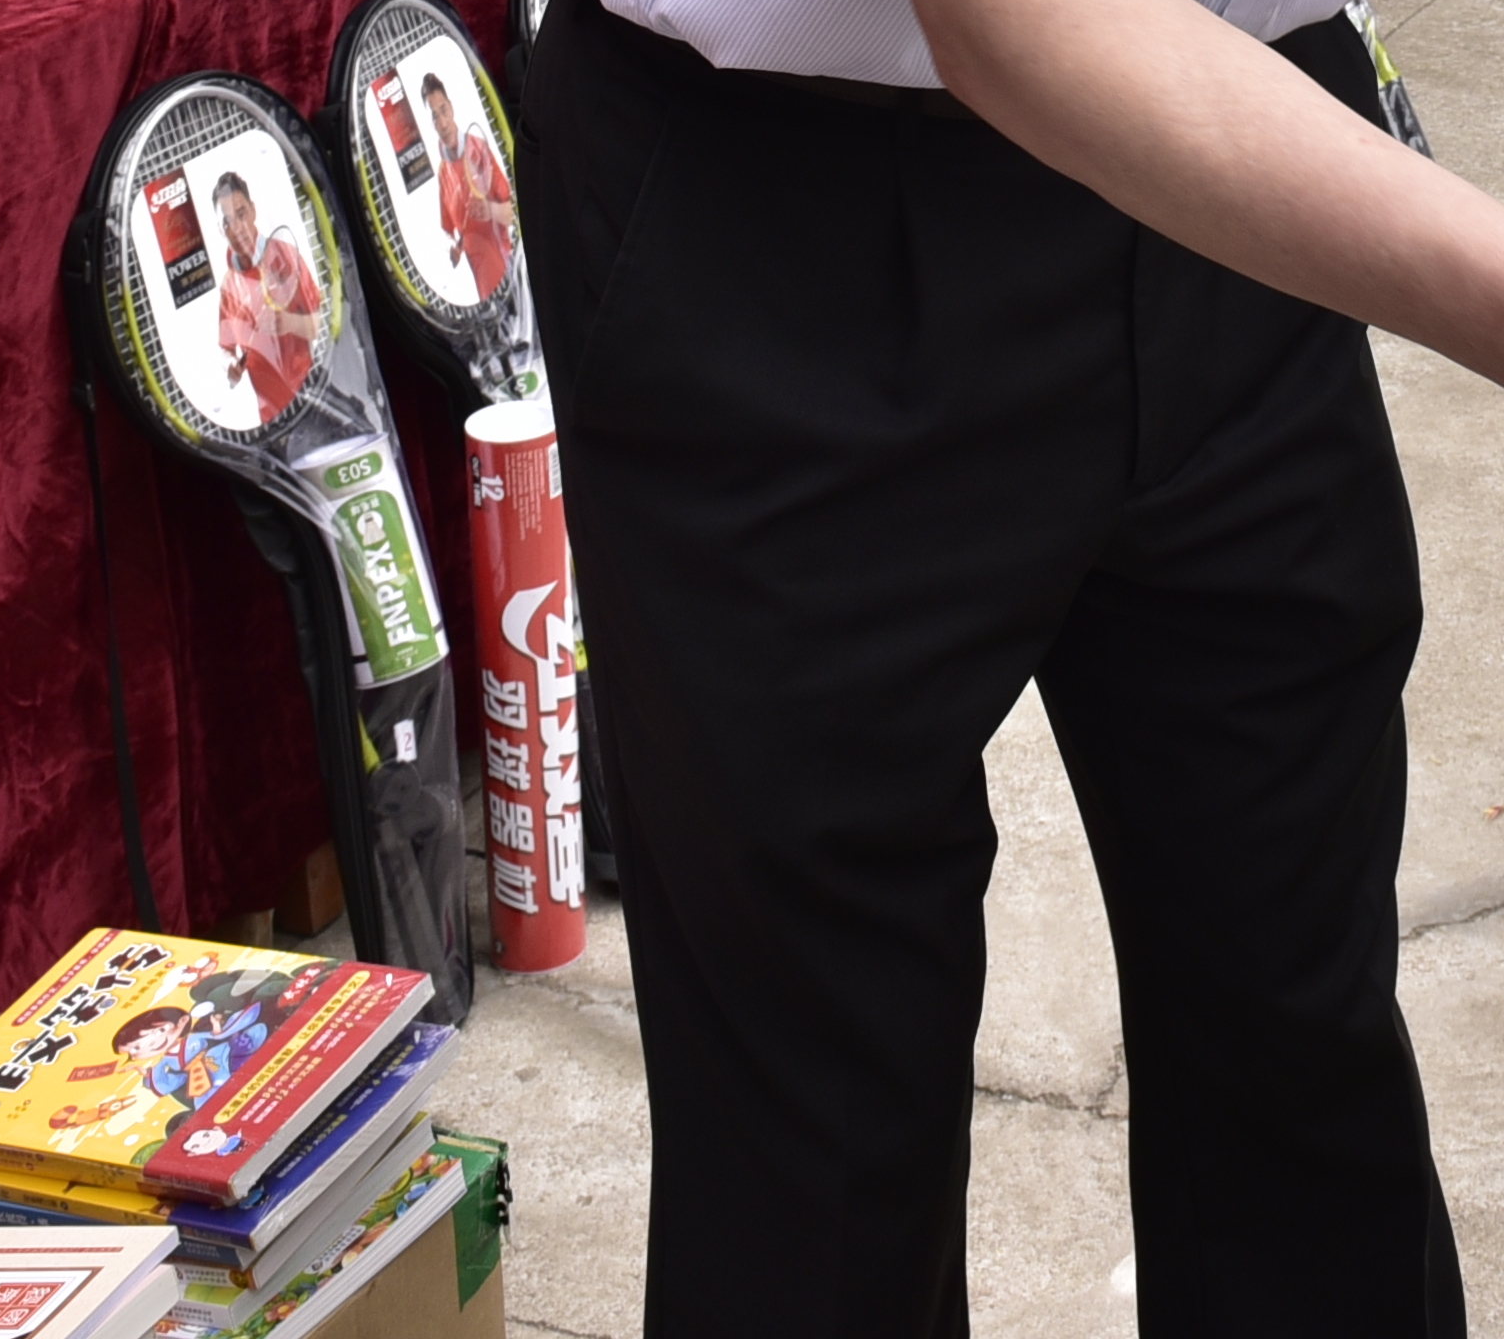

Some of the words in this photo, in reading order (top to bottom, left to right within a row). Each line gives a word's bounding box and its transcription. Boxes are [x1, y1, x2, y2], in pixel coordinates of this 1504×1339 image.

[168, 249, 207, 281] POWER
[338, 458, 372, 483] S03
[481, 474, 505, 502] 12
[364, 541, 425, 648] ENPEX
[481, 668, 539, 915] 羽球器材
